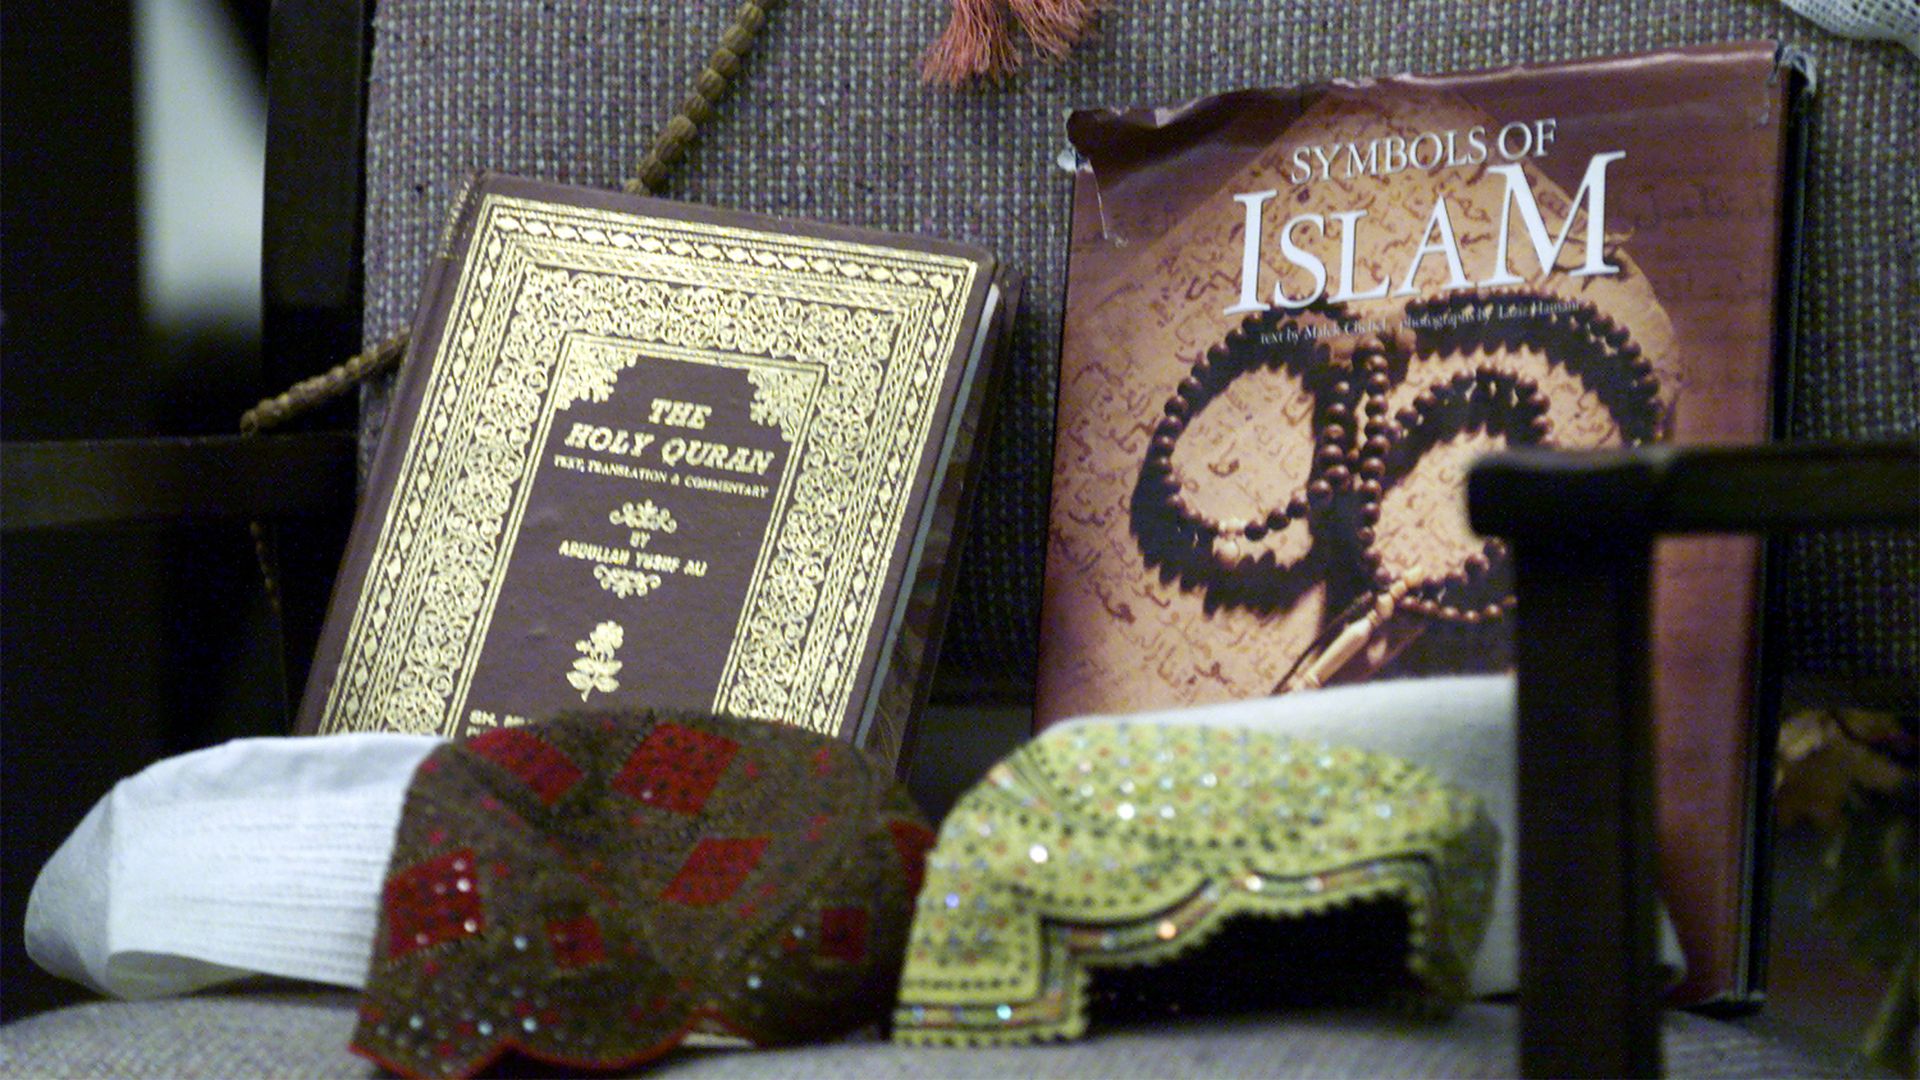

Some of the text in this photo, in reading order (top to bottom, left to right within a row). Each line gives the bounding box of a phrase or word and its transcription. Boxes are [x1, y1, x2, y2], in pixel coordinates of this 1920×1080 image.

[1291, 118, 1556, 184] SYMBOLS OF
[1224, 150, 1627, 316] ISLAM
[648, 398, 712, 430] THE
[564, 422, 775, 476] HOLY QURAN
[588, 459, 668, 484] TRANSLATION
[671, 473, 681, 486] &
[684, 474, 769, 499] COMMENTARY
[558, 540, 630, 566] ABDULLAH
[630, 531, 650, 549] BY
